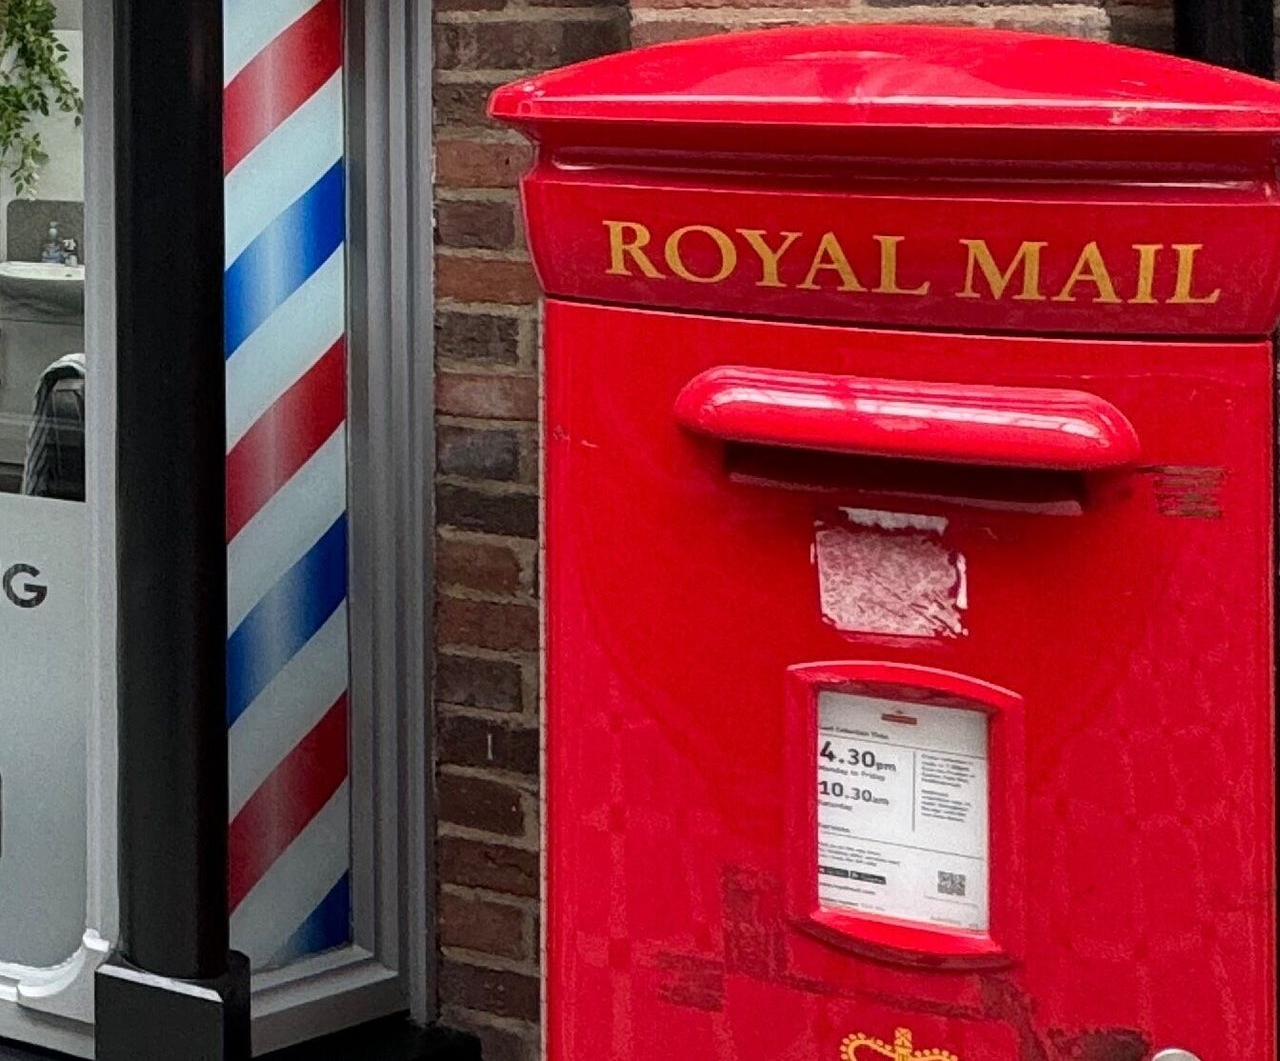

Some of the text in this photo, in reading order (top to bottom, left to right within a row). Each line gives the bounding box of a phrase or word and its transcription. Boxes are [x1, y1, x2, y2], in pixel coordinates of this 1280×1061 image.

[602, 219, 1222, 305] ROYAL MAIL
[820, 741, 897, 772] 4.30pm
[817, 780, 889, 806] 10.30am
